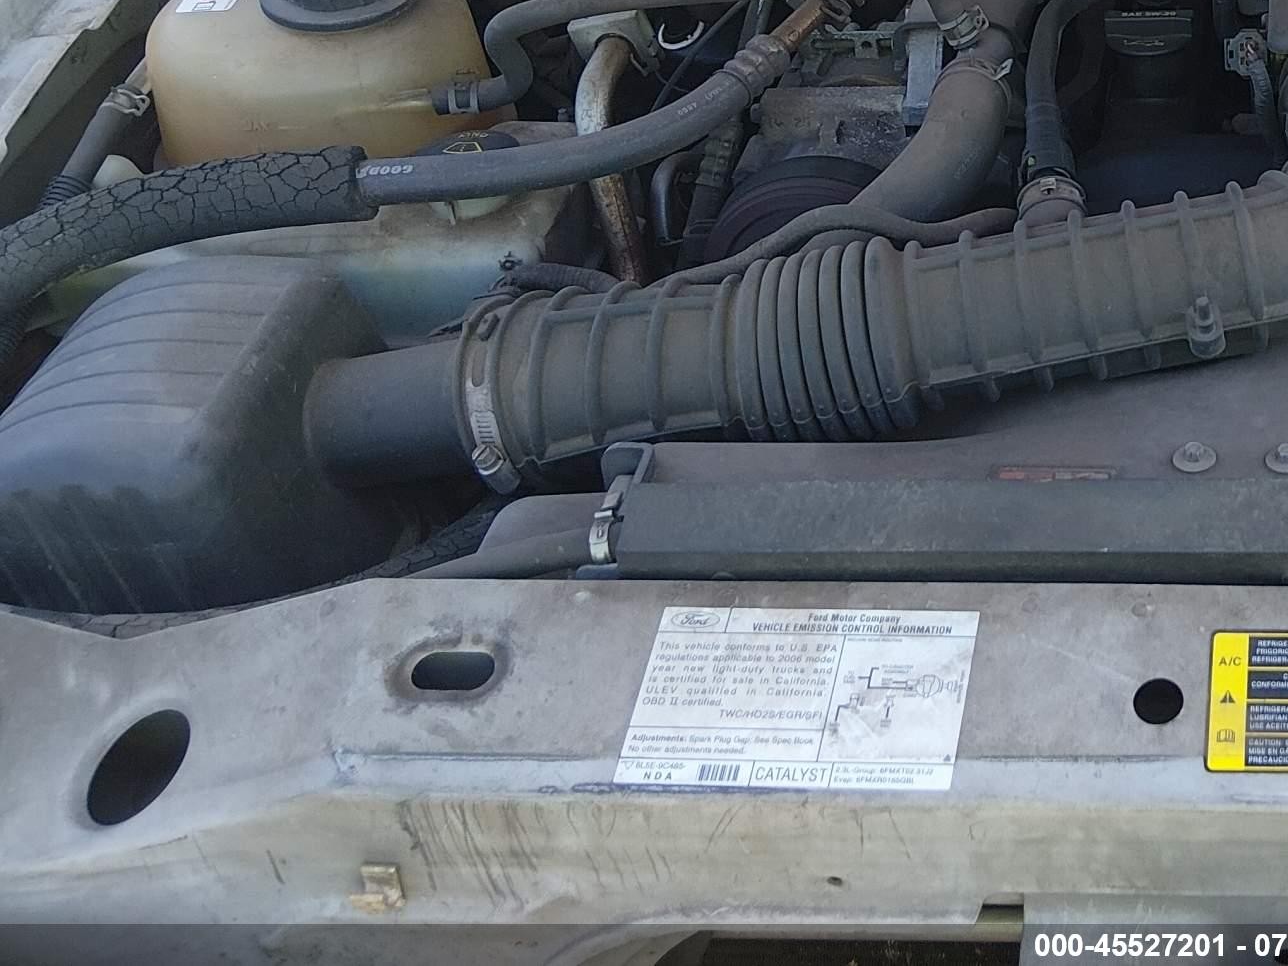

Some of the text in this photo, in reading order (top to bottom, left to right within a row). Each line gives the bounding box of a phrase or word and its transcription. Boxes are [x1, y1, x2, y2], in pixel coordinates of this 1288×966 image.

[680, 613, 710, 626] Ford
[808, 612, 902, 624] Ford Motor Company
[752, 622, 953, 634] VEHICLE EMISSION CONTROL INFORMATION
[659, 642, 837, 652] This vehicle conforms to EPA
[655, 654, 836, 664] regulations applicable to model
[1218, 657, 1242, 666] A/C
[650, 666, 676, 674] year
[712, 665, 764, 675] light-duty
[772, 666, 805, 674] trucks
[812, 666, 832, 674] and
[663, 675, 706, 683] certified
[712, 675, 727, 683] for
[732, 676, 754, 684] sale
[759, 676, 769, 684] in
[645, 686, 678, 695] ULEV
[686, 687, 737, 696] qualified
[746, 687, 756, 696] in
[642, 697, 724, 707] OBD certified.
[754, 766, 827, 783] CATALYST
